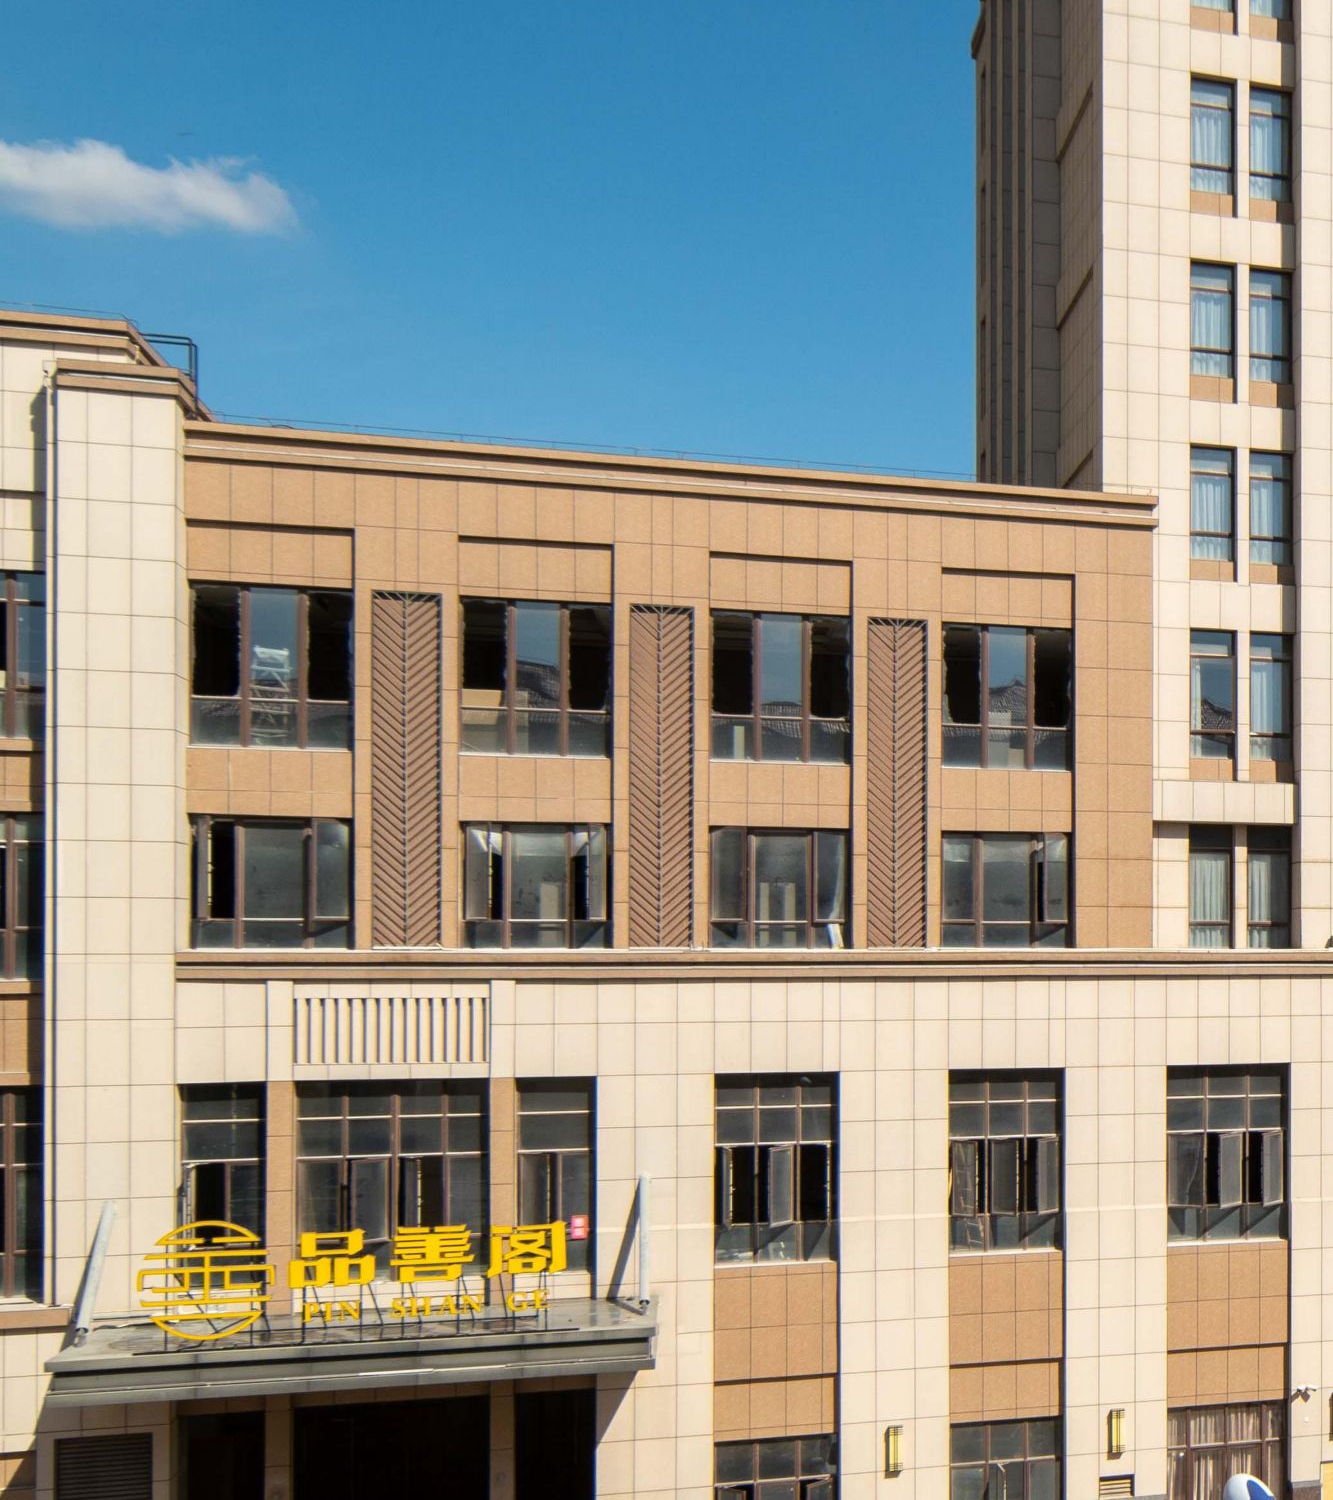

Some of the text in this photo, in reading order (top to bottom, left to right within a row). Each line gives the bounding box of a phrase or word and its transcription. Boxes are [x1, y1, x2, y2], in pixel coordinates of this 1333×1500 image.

[288, 1220, 568, 1289] 品善阁
[304, 1290, 550, 1323] PIN SHAN GE
